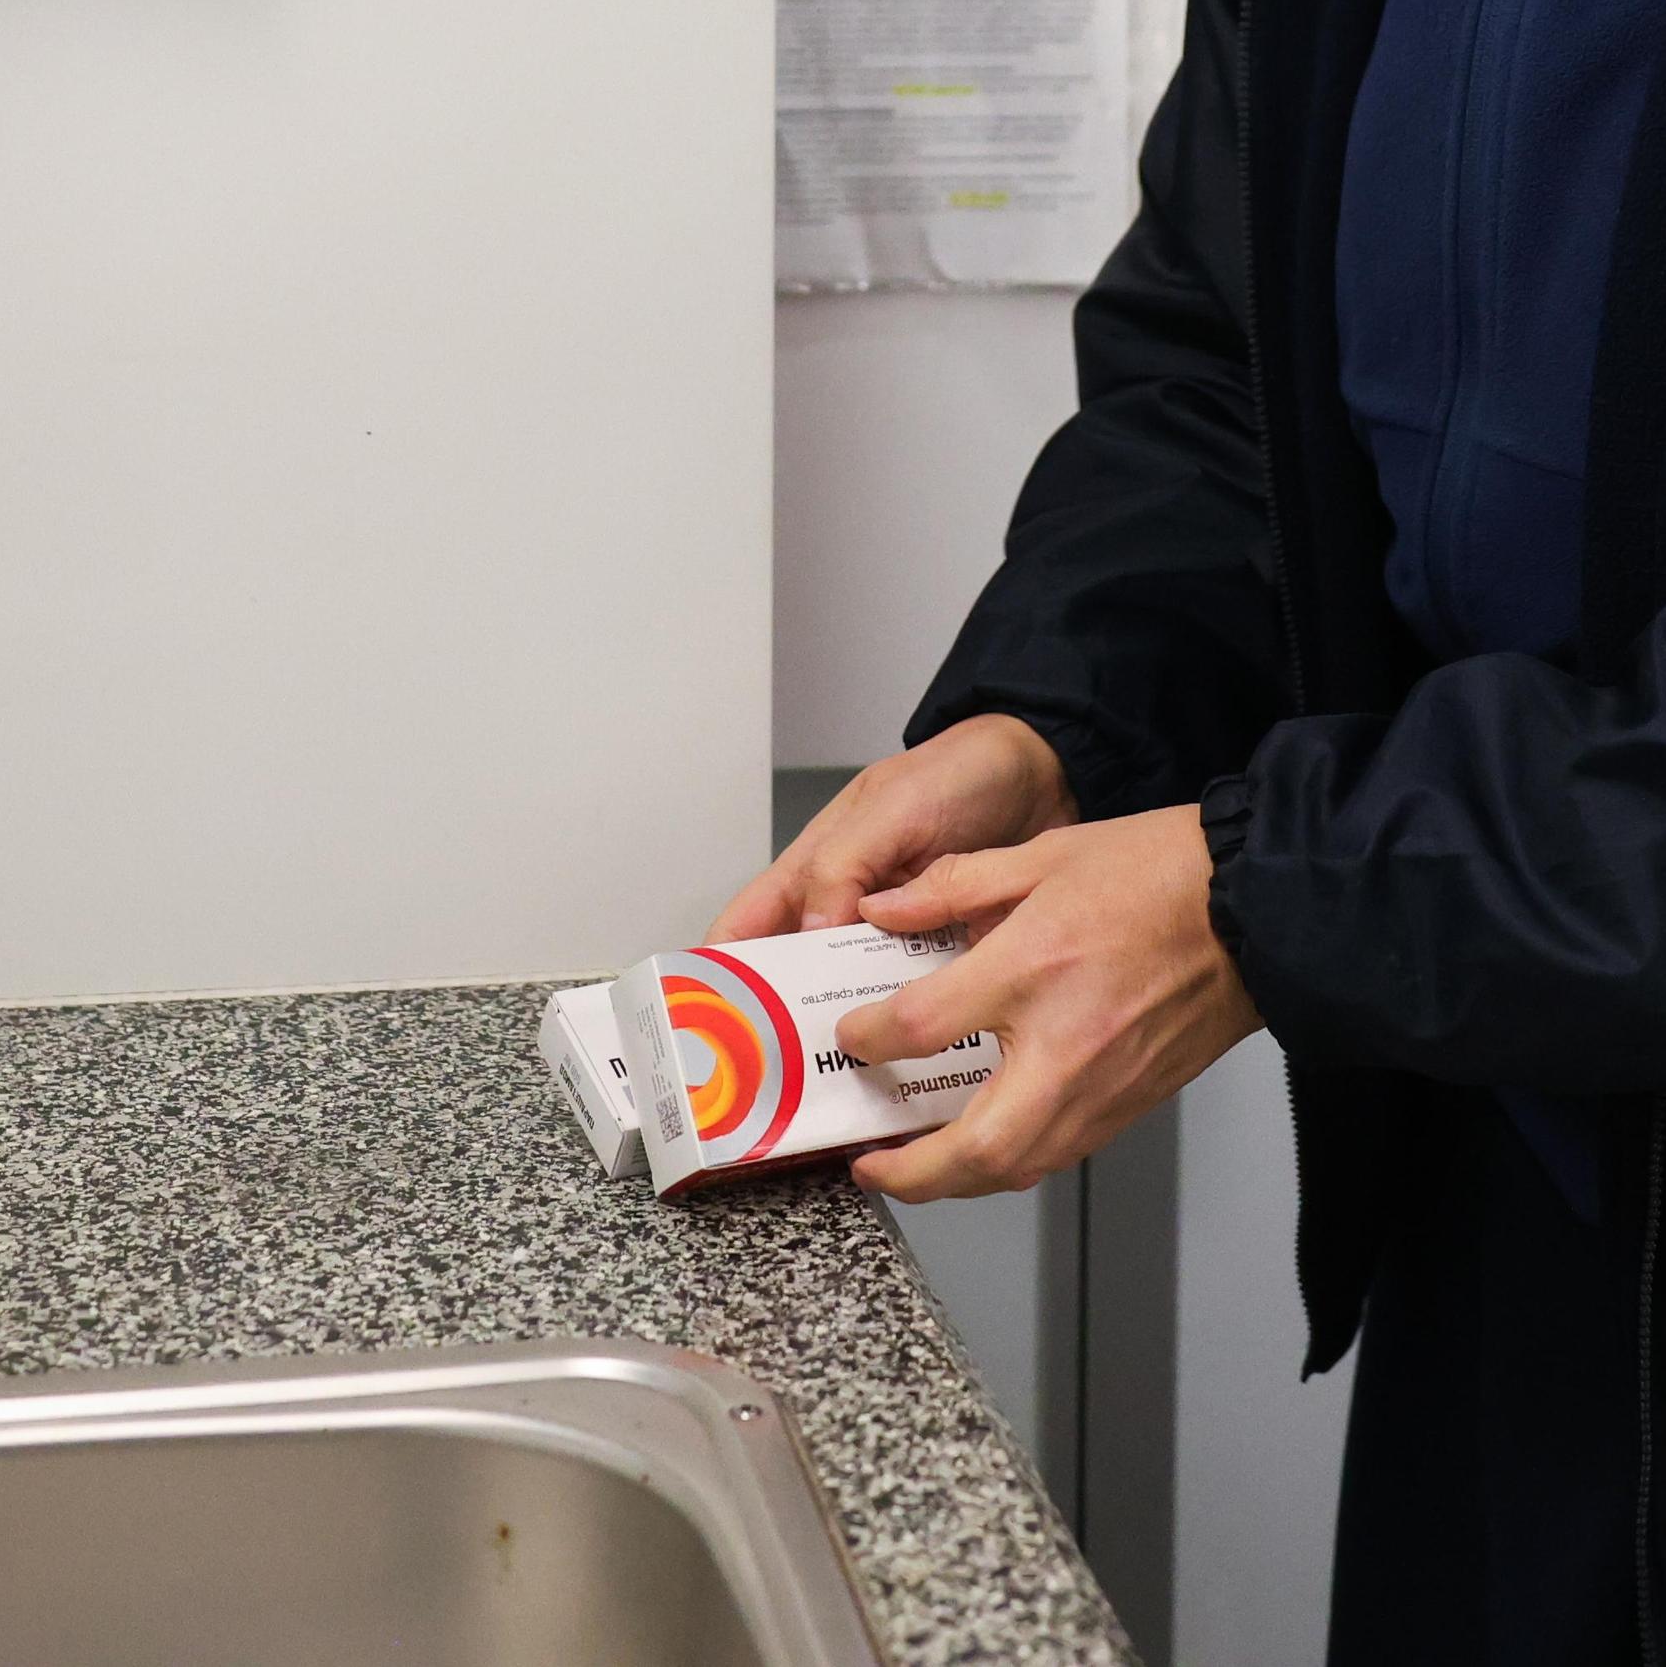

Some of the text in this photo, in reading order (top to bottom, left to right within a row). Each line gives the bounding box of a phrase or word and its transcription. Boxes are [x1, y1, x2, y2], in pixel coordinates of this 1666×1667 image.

[910, 942, 922, 952] 40
[801, 979, 911, 1006] тическое средство
